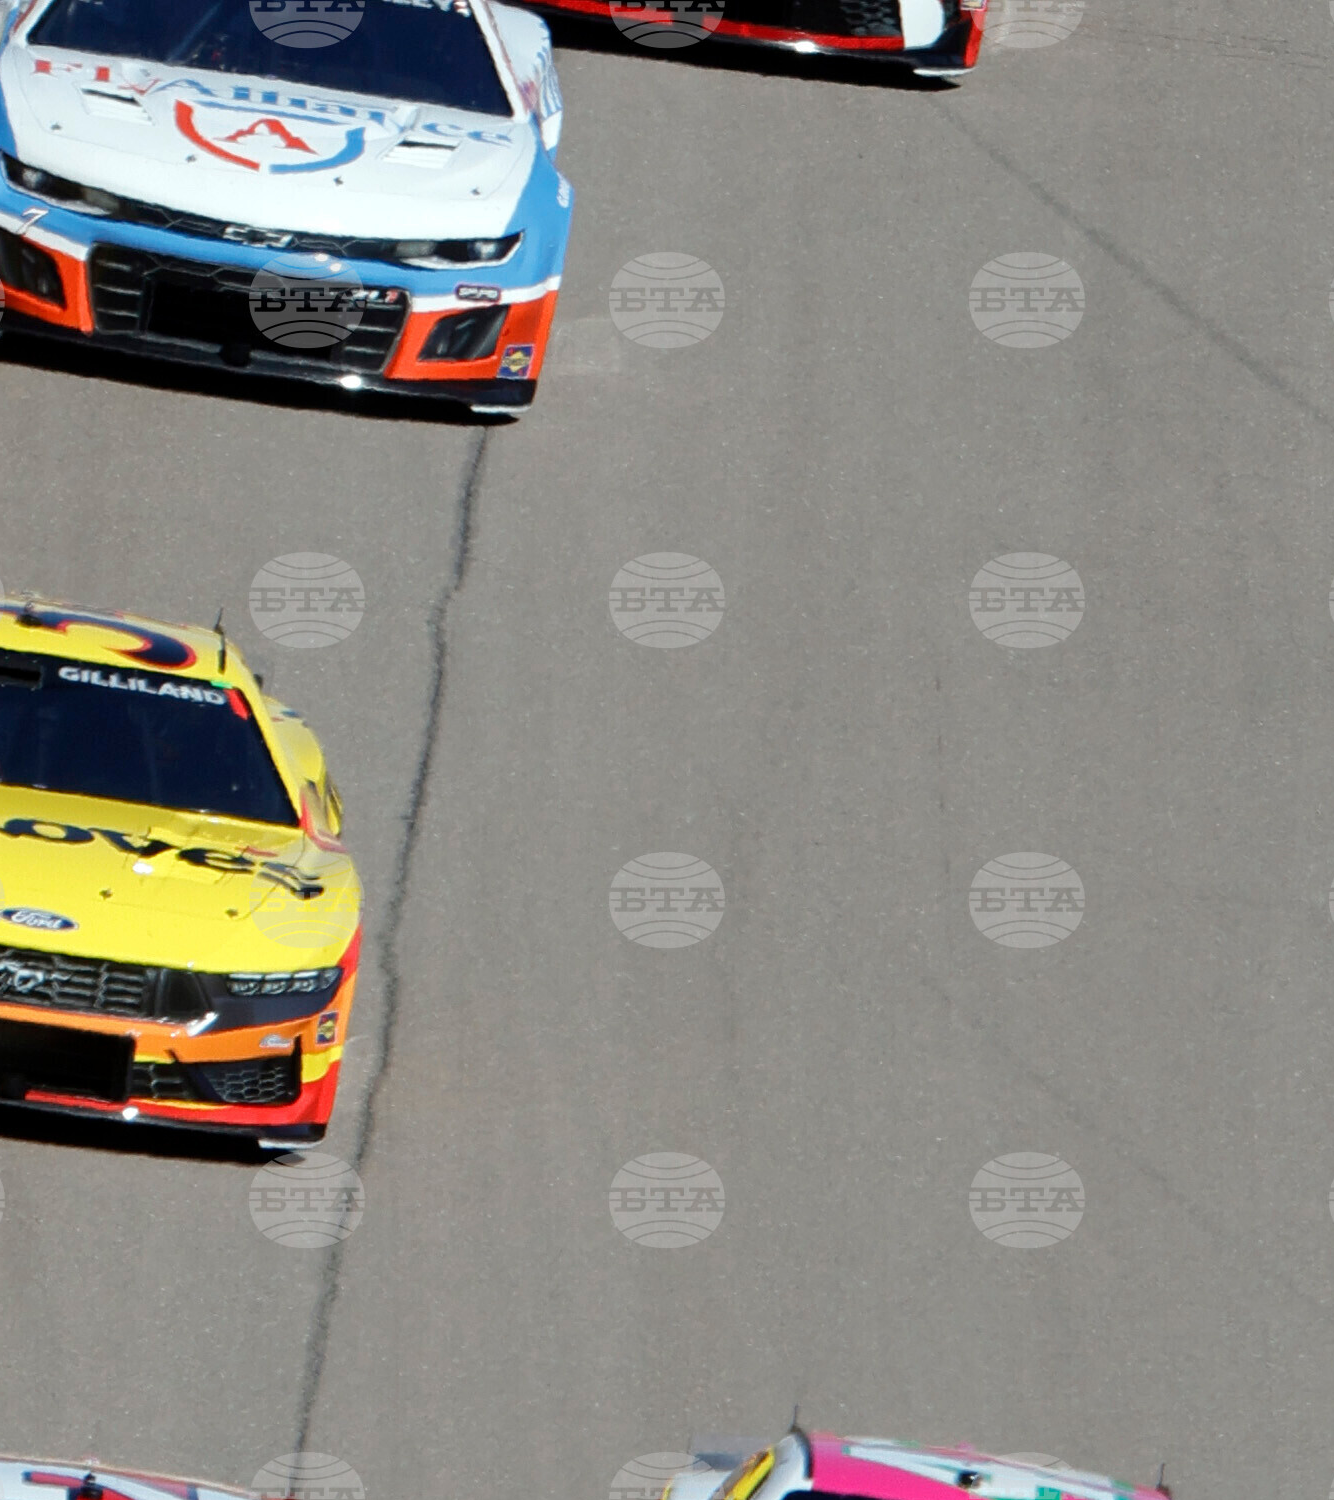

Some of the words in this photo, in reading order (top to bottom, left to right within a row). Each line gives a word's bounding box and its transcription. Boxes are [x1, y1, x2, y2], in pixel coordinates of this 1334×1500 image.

[17, 207, 49, 236] 7
[58, 665, 227, 706] GILLILAND
[4, 908, 71, 931] Ford
